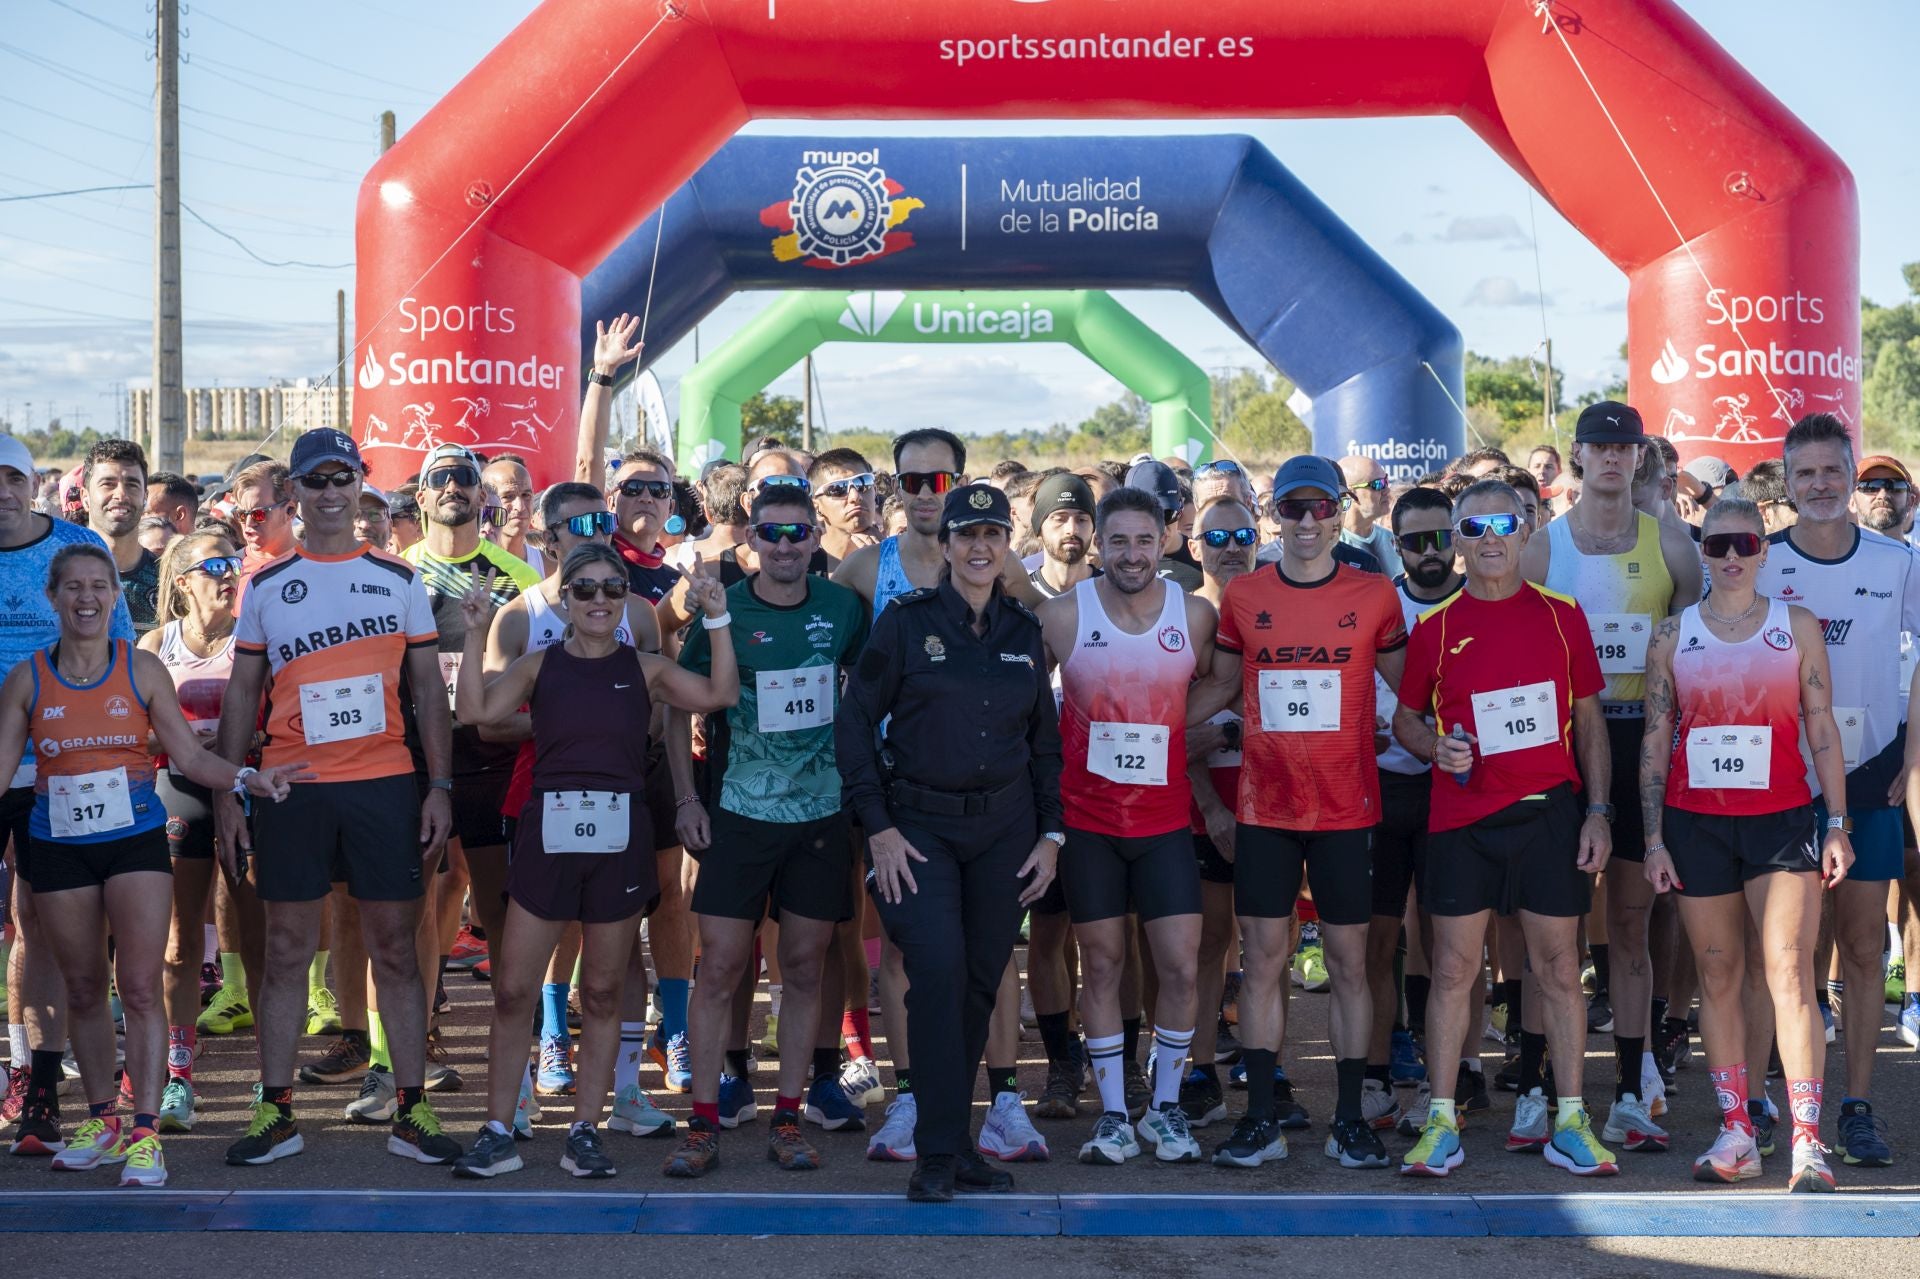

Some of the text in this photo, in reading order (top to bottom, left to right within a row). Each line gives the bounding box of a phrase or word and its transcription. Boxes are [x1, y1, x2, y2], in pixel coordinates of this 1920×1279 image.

[939, 30, 1255, 67] sportssantander.es
[802, 147, 880, 169] mupol
[1000, 176, 1141, 202] Mutualidad
[1000, 205, 1159, 234] de la Policía
[398, 297, 516, 342] Sports
[1706, 288, 1825, 333] Sports
[912, 302, 1054, 340] Unicaja
[388, 350, 565, 390] Santander
[1694, 341, 1860, 383] Santander
[335, 436, 352, 453] EF
[1346, 437, 1448, 460] fundación
[1383, 460, 1430, 480] upol
[361, 583, 391, 598] CORTES
[1870, 590, 1893, 599] mupol
[278, 614, 399, 664] BARBARIS
[1083, 640, 1109, 648] VIATOR
[1255, 646, 1353, 664] ASFAS
[1681, 645, 1706, 654] VIATOR
[785, 698, 815, 715] 418
[1287, 701, 1310, 717] 96
[329, 708, 363, 728] 303
[1504, 717, 1537, 736] 105
[60, 734, 139, 750] GRANISUL
[1114, 753, 1147, 770] 122
[1711, 757, 1745, 773] 149
[72, 802, 106, 822] 317
[574, 822, 597, 838] 60
[1792, 1081, 1822, 1094] SOLE
